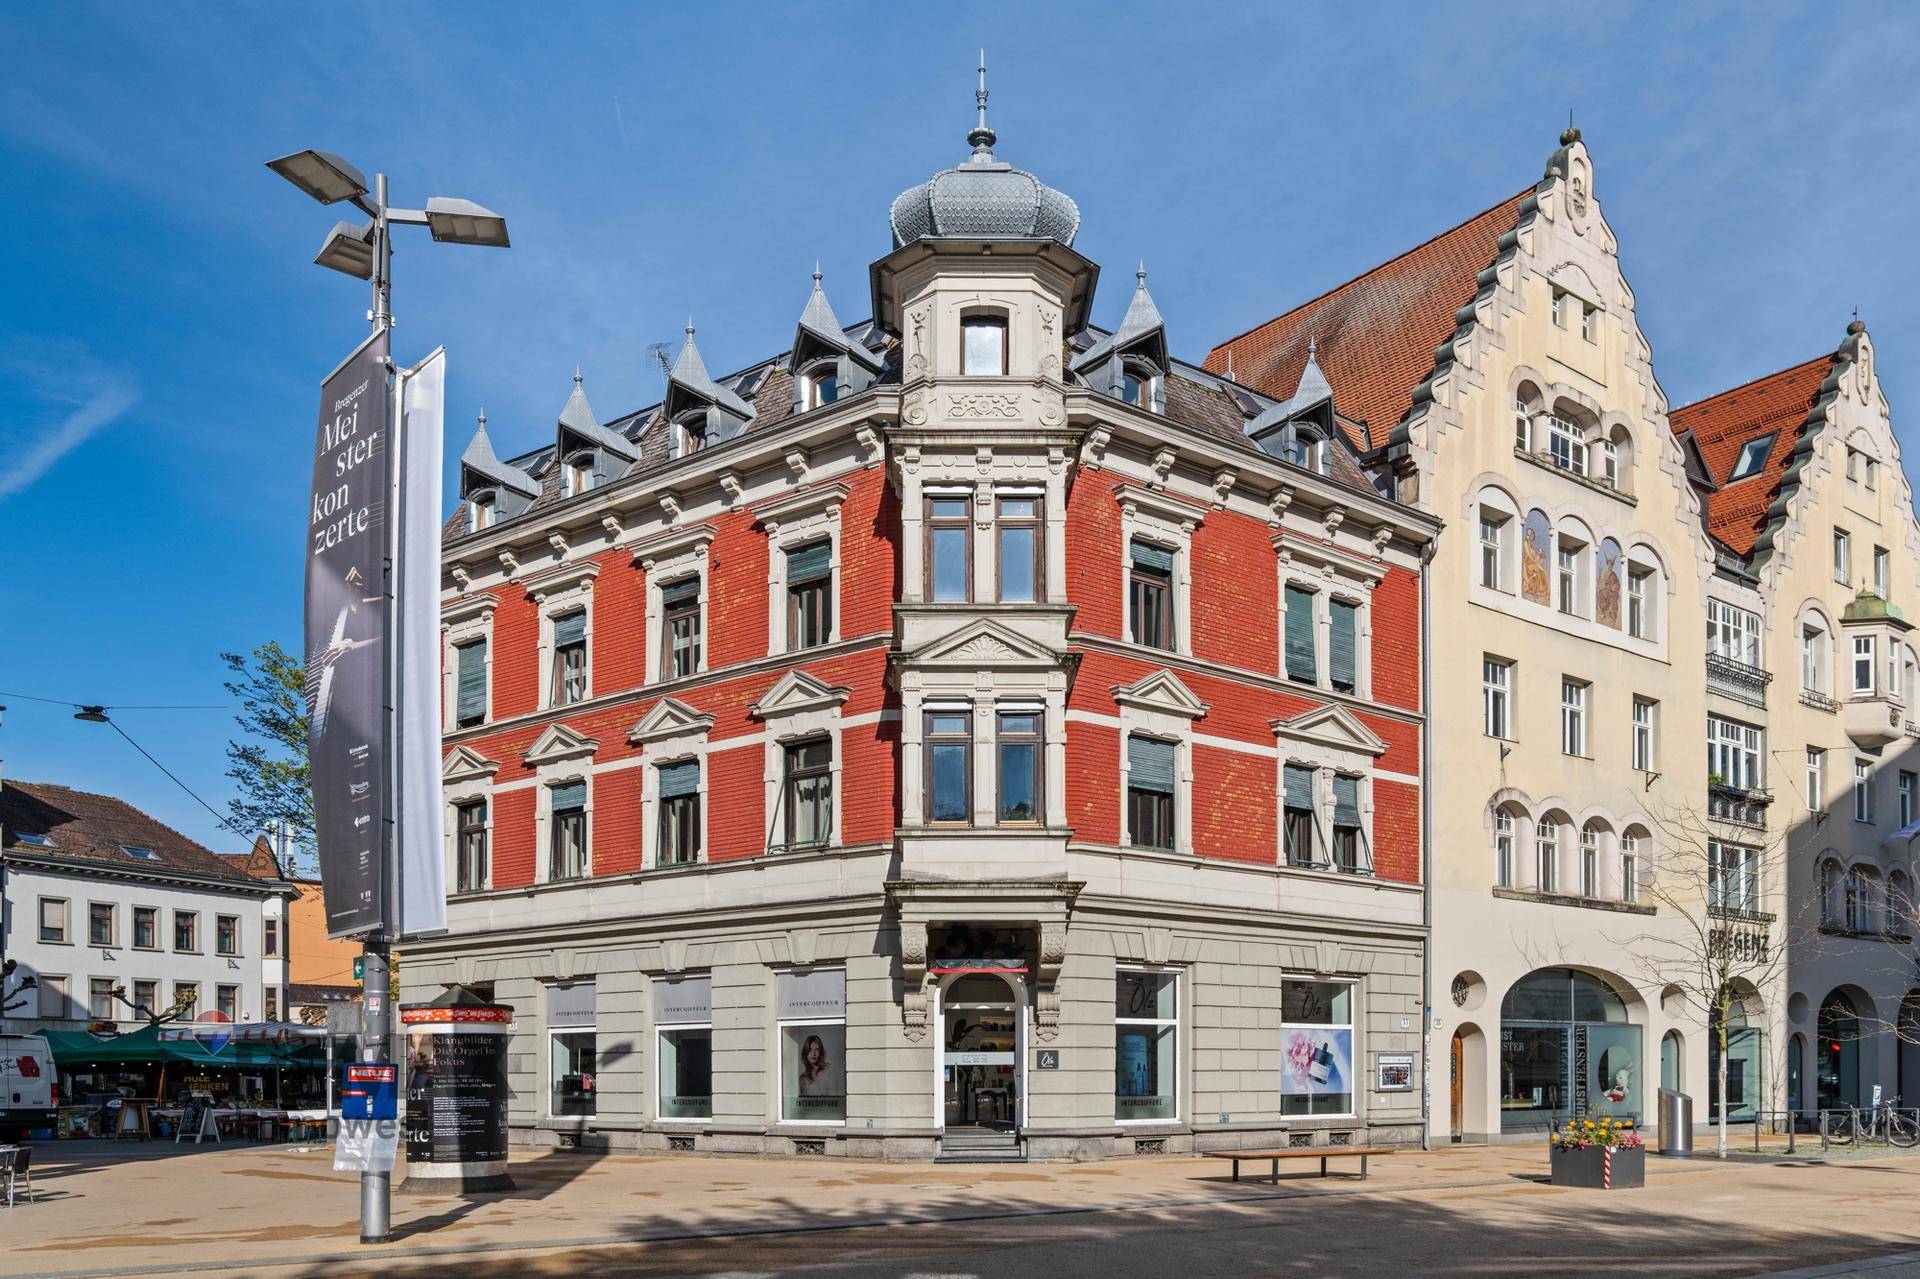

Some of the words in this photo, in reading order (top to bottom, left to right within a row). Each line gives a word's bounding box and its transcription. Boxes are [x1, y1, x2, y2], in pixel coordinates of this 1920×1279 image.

[334, 378, 369, 413] Bregenzer
[321, 402, 358, 457] Mei
[336, 431, 377, 478] ster
[312, 483, 350, 525] kon
[314, 504, 370, 556] zerte
[1709, 928, 1770, 952] BREGENZ
[433, 1036, 495, 1047] Klangbilder.
[433, 1047, 452, 1055] Die
[454, 1047, 483, 1057] Orgel
[351, 1069, 392, 1077] NEUE
[433, 1057, 465, 1066] Fokus
[1576, 1083, 1586, 1115] UNST
